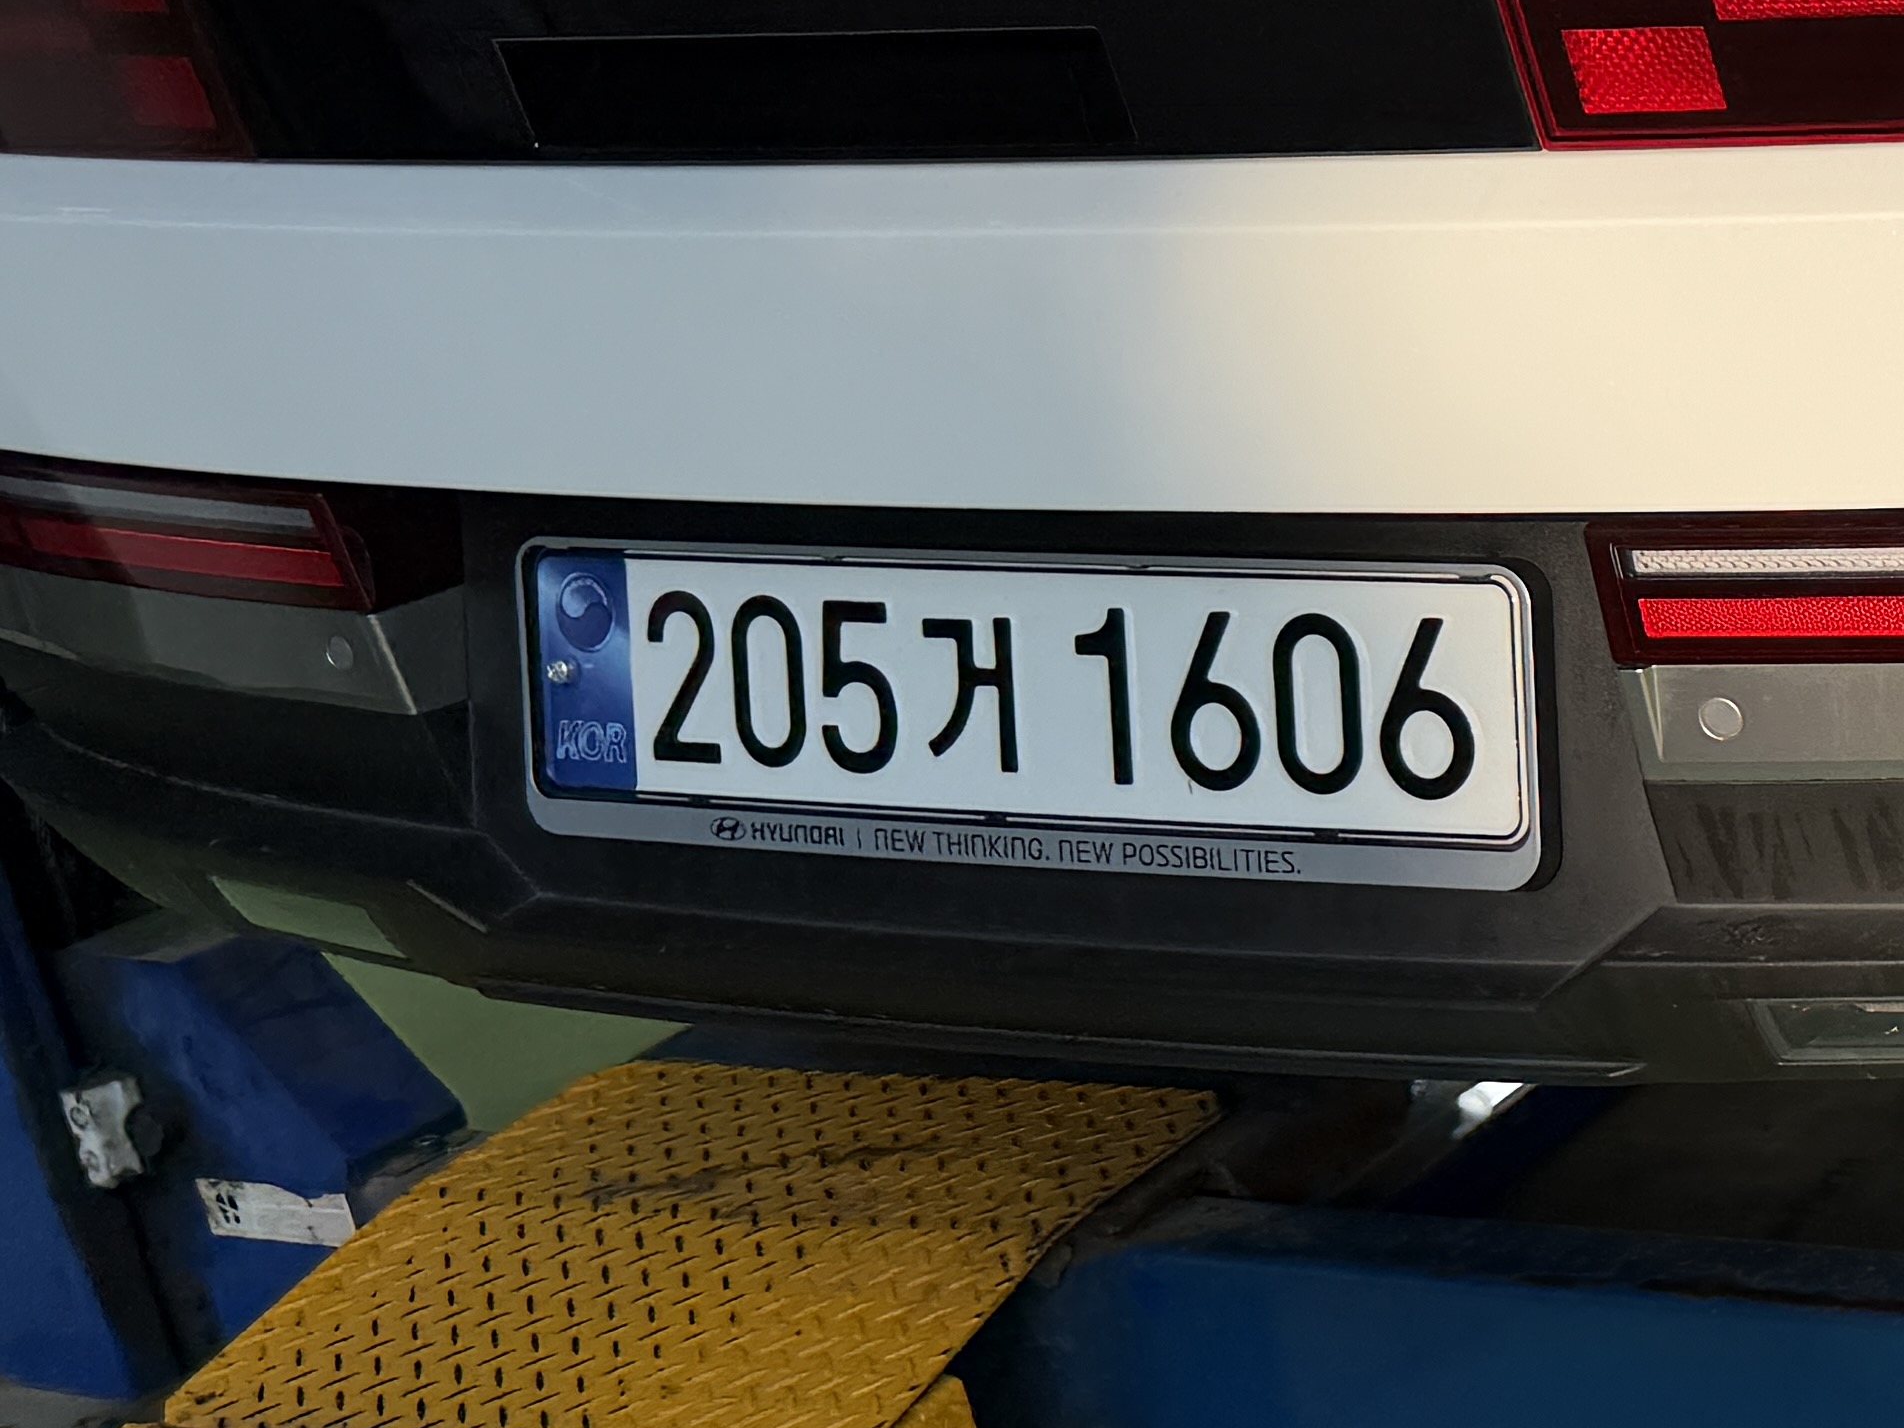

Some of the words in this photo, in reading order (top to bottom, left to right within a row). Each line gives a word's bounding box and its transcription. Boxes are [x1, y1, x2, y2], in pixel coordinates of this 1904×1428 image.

[645, 589, 1020, 775] 205거
[1074, 606, 1476, 801] 1606
[556, 719, 628, 764] KOR
[750, 821, 845, 847] HYUNDAI
[873, 827, 926, 855] NEW
[932, 830, 1051, 862] THINKING.
[1058, 838, 1114, 865] NEW
[1122, 842, 1302, 875] POSSIBILITIES.
